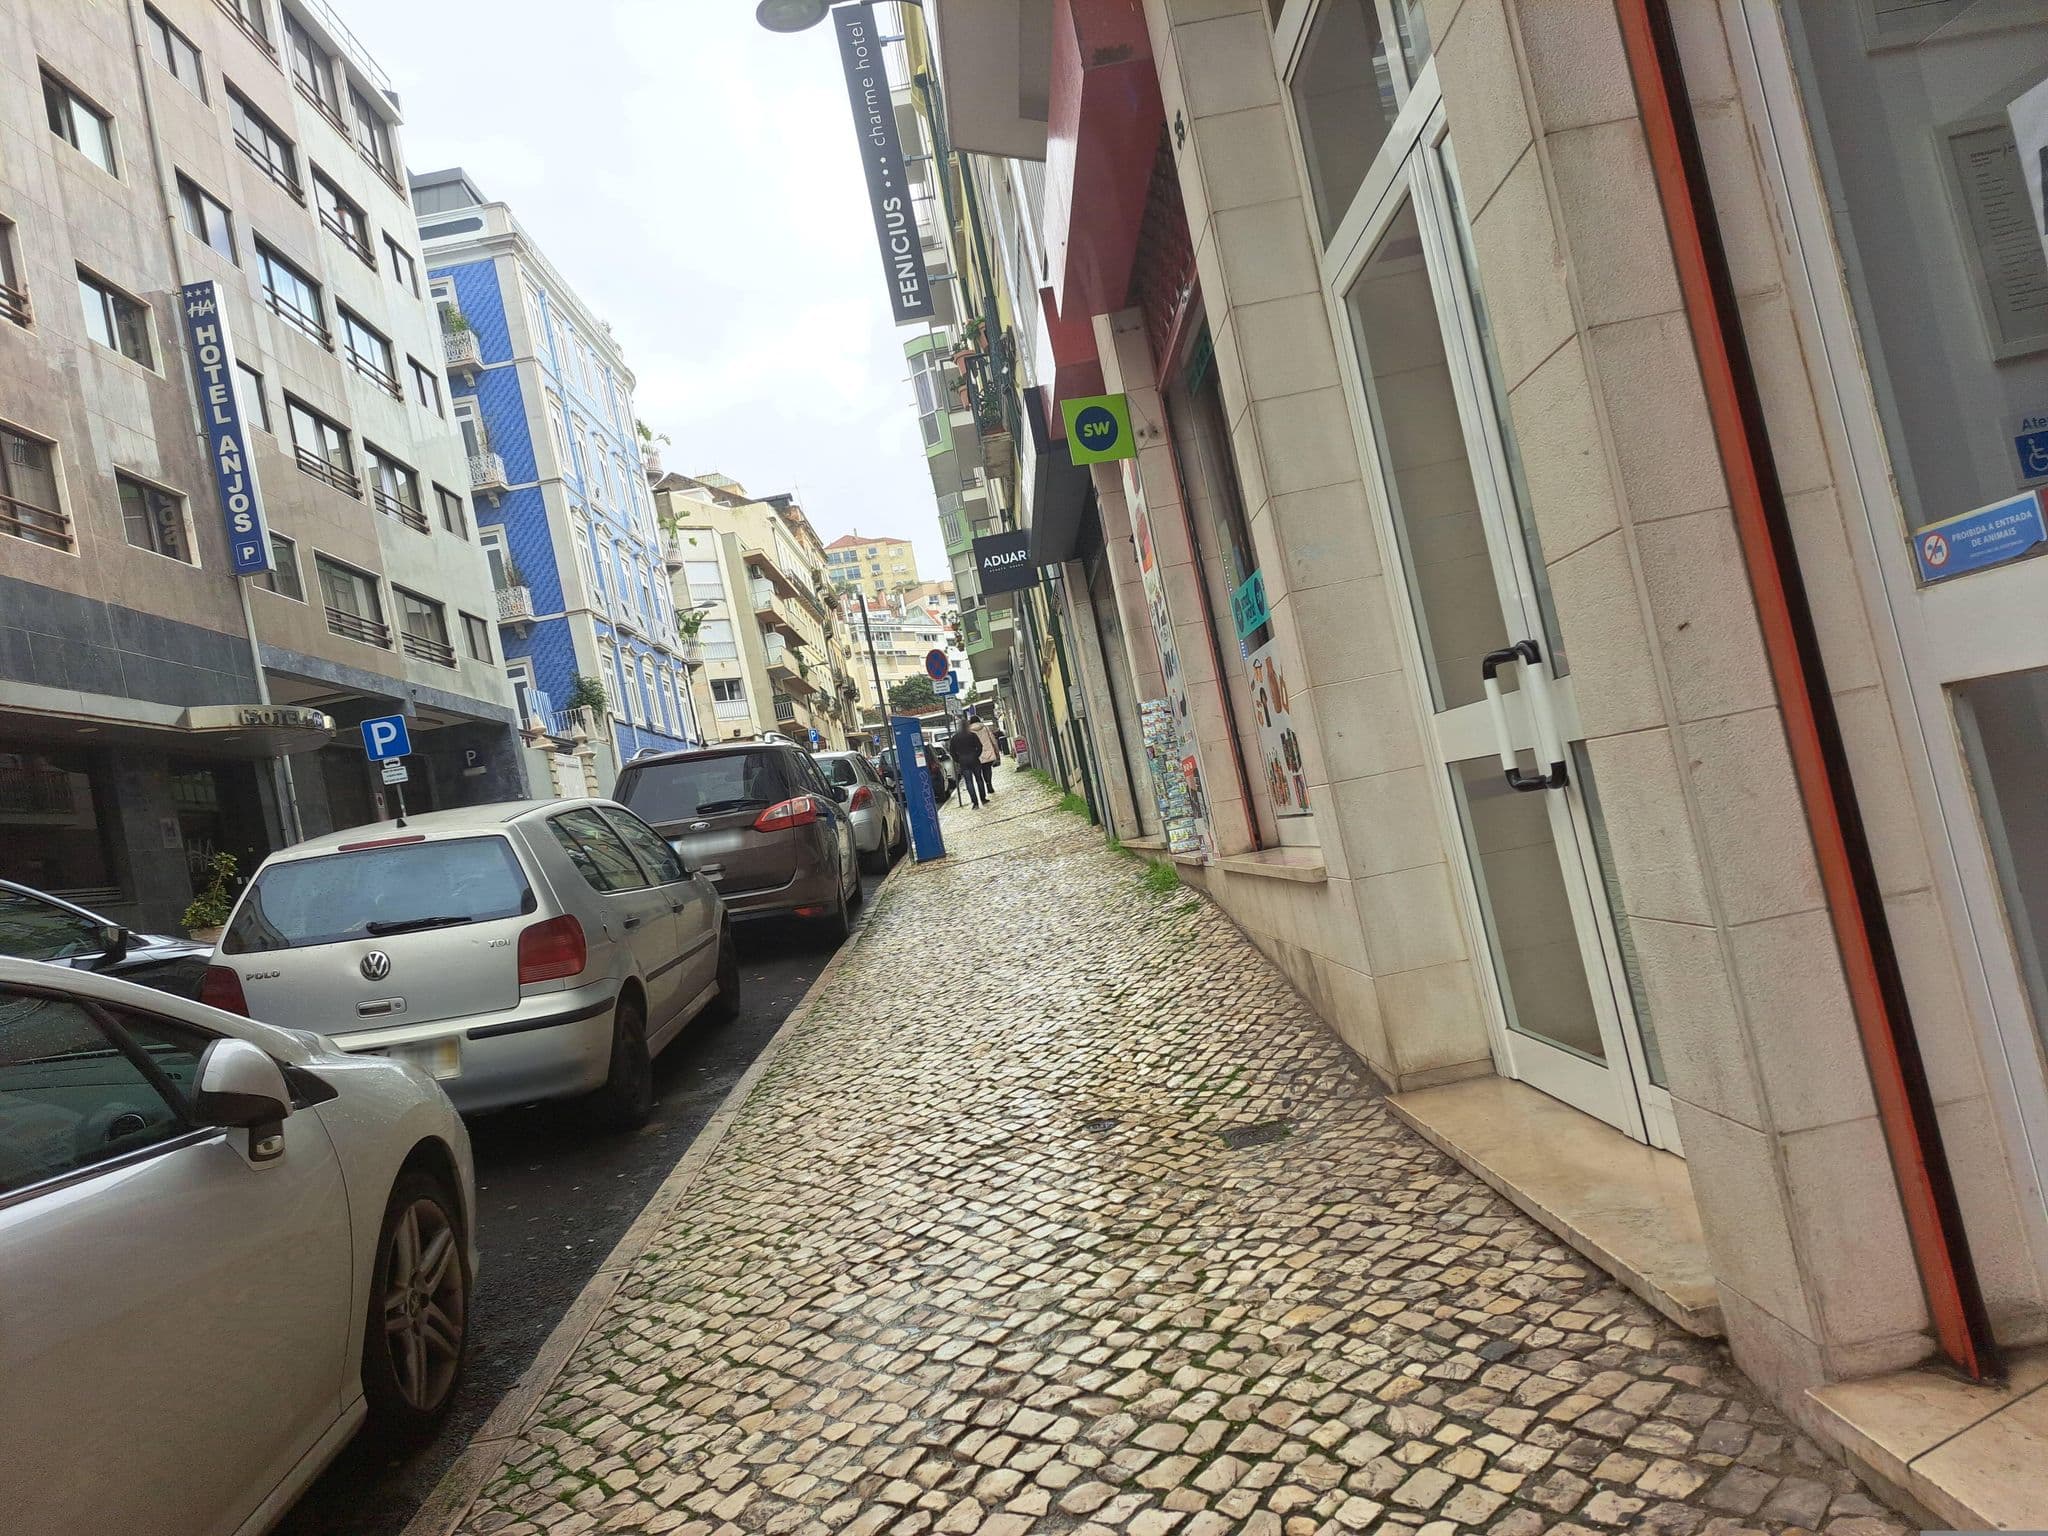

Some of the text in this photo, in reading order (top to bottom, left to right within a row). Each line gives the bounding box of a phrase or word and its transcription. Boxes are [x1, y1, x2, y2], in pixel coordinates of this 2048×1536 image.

[846, 21, 922, 308] FENICIUS charme hotel
[195, 324, 252, 533] HOTEL ANJOS
[1083, 421, 1110, 437] SW
[2022, 415, 2048, 432] Ate
[1952, 525, 1987, 542] PROIBIDA
[1995, 510, 2033, 528] ENTRADA
[1971, 527, 2017, 547] DE ANIMAIS
[243, 547, 255, 560] P
[983, 550, 1027, 568] ADUAR
[371, 721, 397, 755] P
[466, 750, 477, 766] P
[487, 938, 510, 948] TDI
[246, 969, 280, 981] POLO
